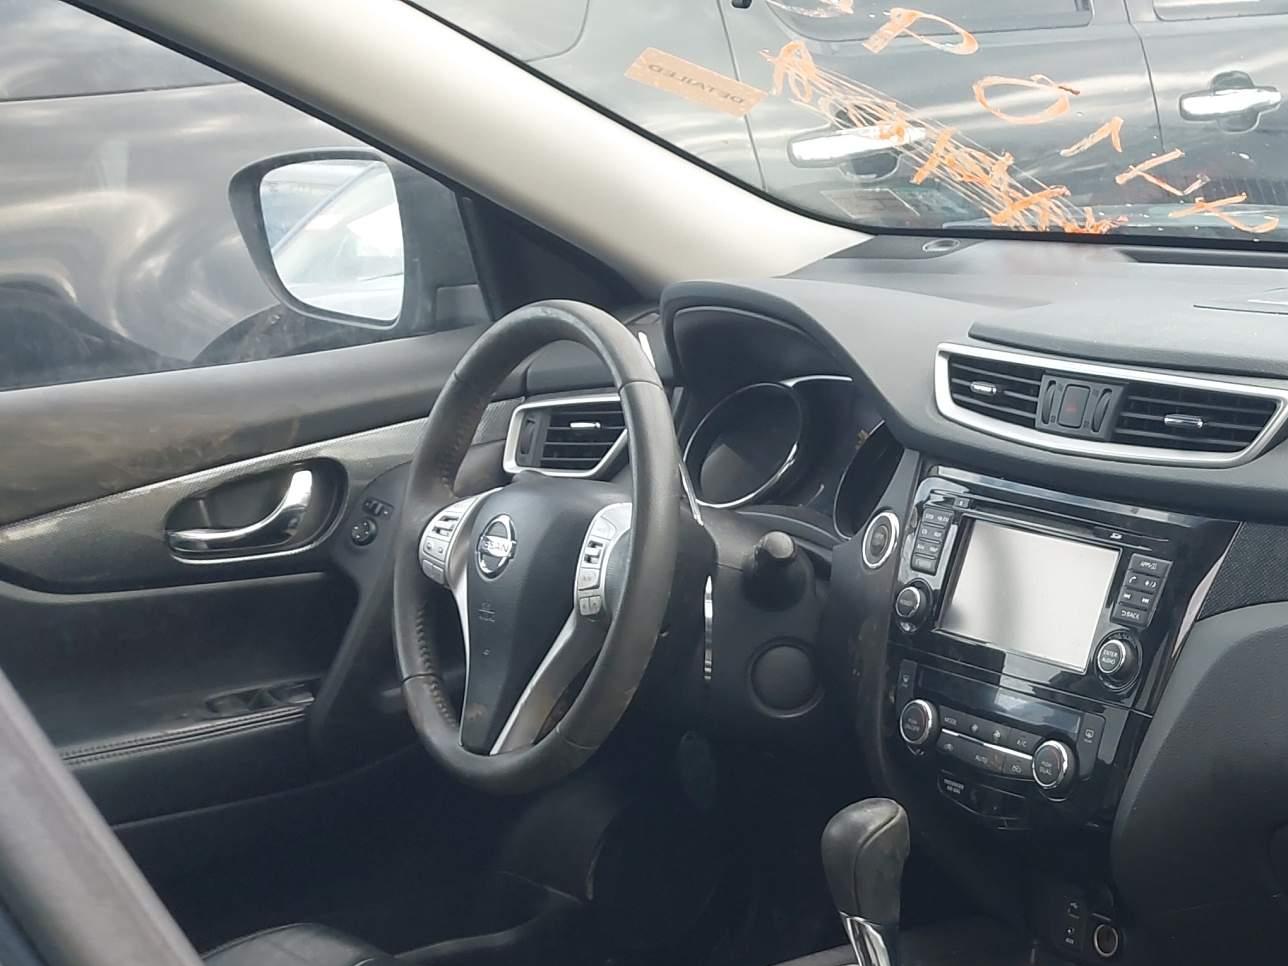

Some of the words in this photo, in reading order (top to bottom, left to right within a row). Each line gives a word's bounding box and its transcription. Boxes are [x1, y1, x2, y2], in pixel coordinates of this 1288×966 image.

[1126, 611, 1140, 620] BACK
[1103, 649, 1118, 658] ENTER
[1101, 657, 1116, 665] AUDIO
